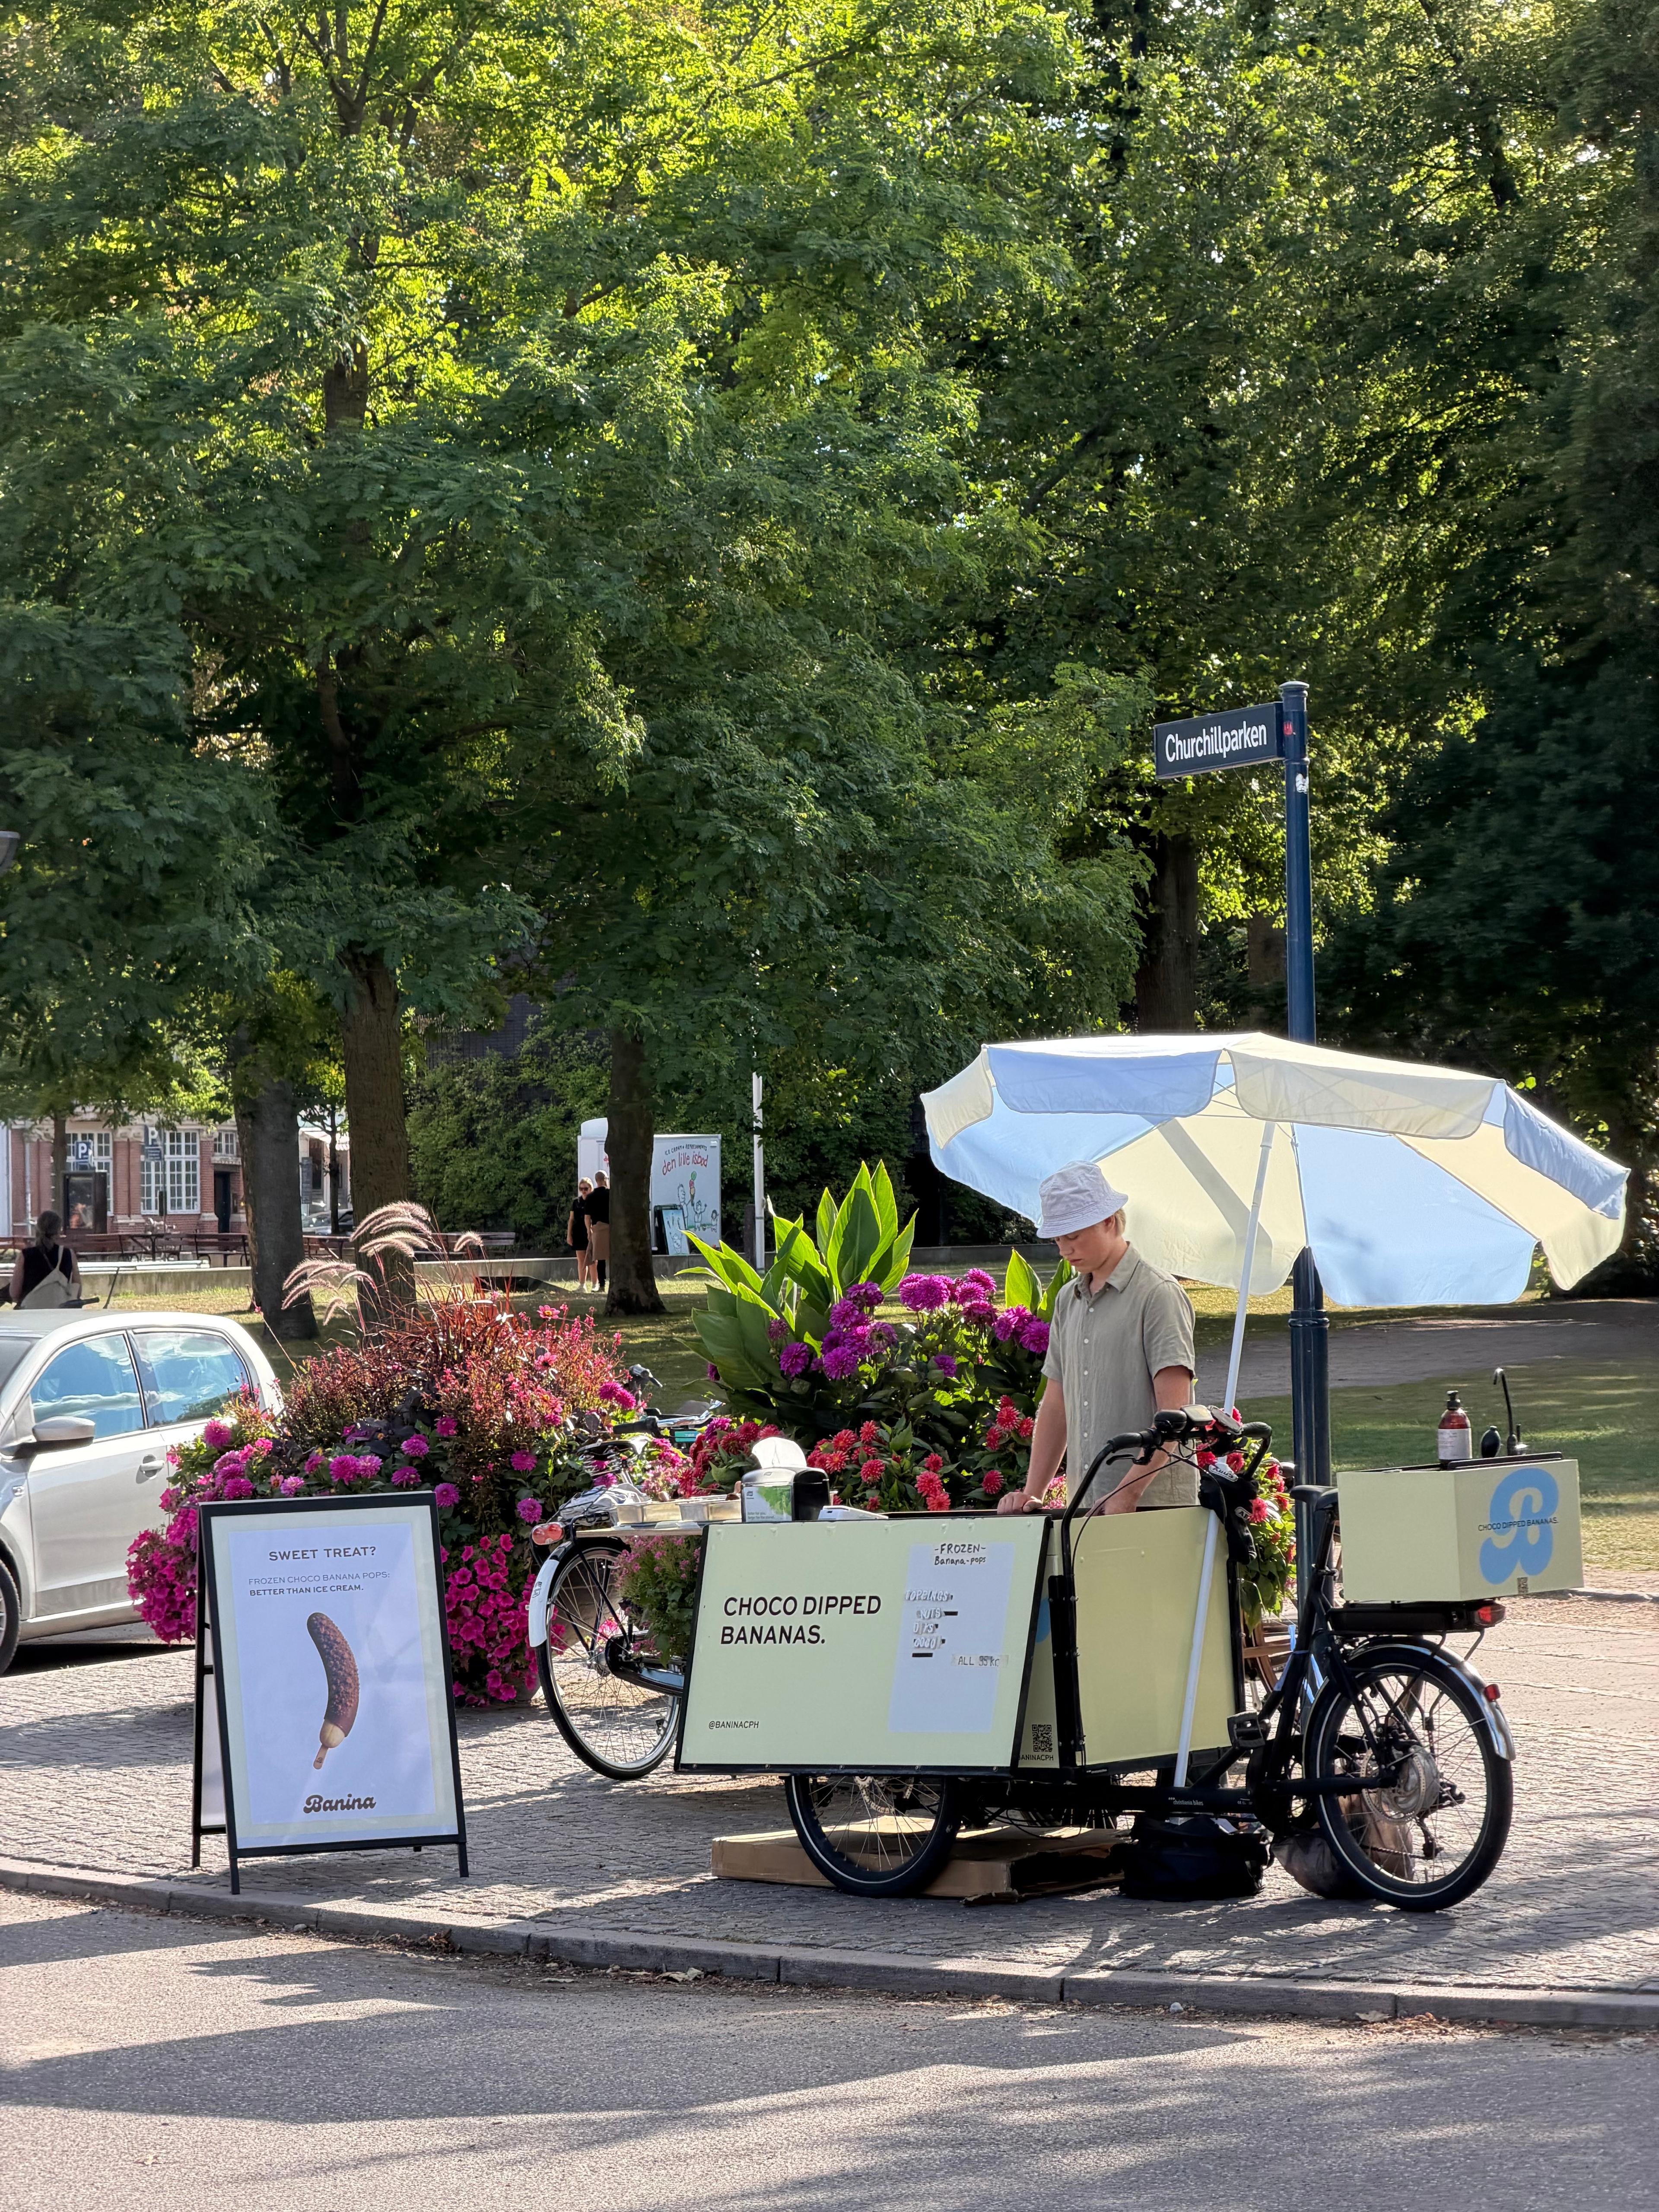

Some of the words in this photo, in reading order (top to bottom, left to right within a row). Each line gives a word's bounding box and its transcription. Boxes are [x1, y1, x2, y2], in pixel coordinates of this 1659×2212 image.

[1165, 721, 1267, 763] Churchillparken
[148, 1127, 159, 1145] P
[78, 1143, 87, 1159] P
[662, 1159, 676, 1176] den
[678, 1151, 690, 1167] lille
[1478, 1522, 1501, 1532] CHOCO
[1502, 1520, 1526, 1529] DIPPED
[269, 1549, 318, 1561] SWEET
[324, 1546, 376, 1558] TREAT?
[934, 1555, 986, 1566] Banana-pops
[248, 1576, 286, 1585] FROZEN
[287, 1575, 321, 1583] CHOCO
[322, 1573, 361, 1581] BANANA
[249, 1588, 285, 1596] BETTER
[724, 1596, 798, 1616] CHOCO
[803, 1595, 881, 1615] DIPPED
[720, 1624, 826, 1645] BANANAS.
[958, 1656, 974, 1665] ALL
[709, 1720, 759, 1729] @BANINACPH
[303, 1793, 377, 1814] Banina
